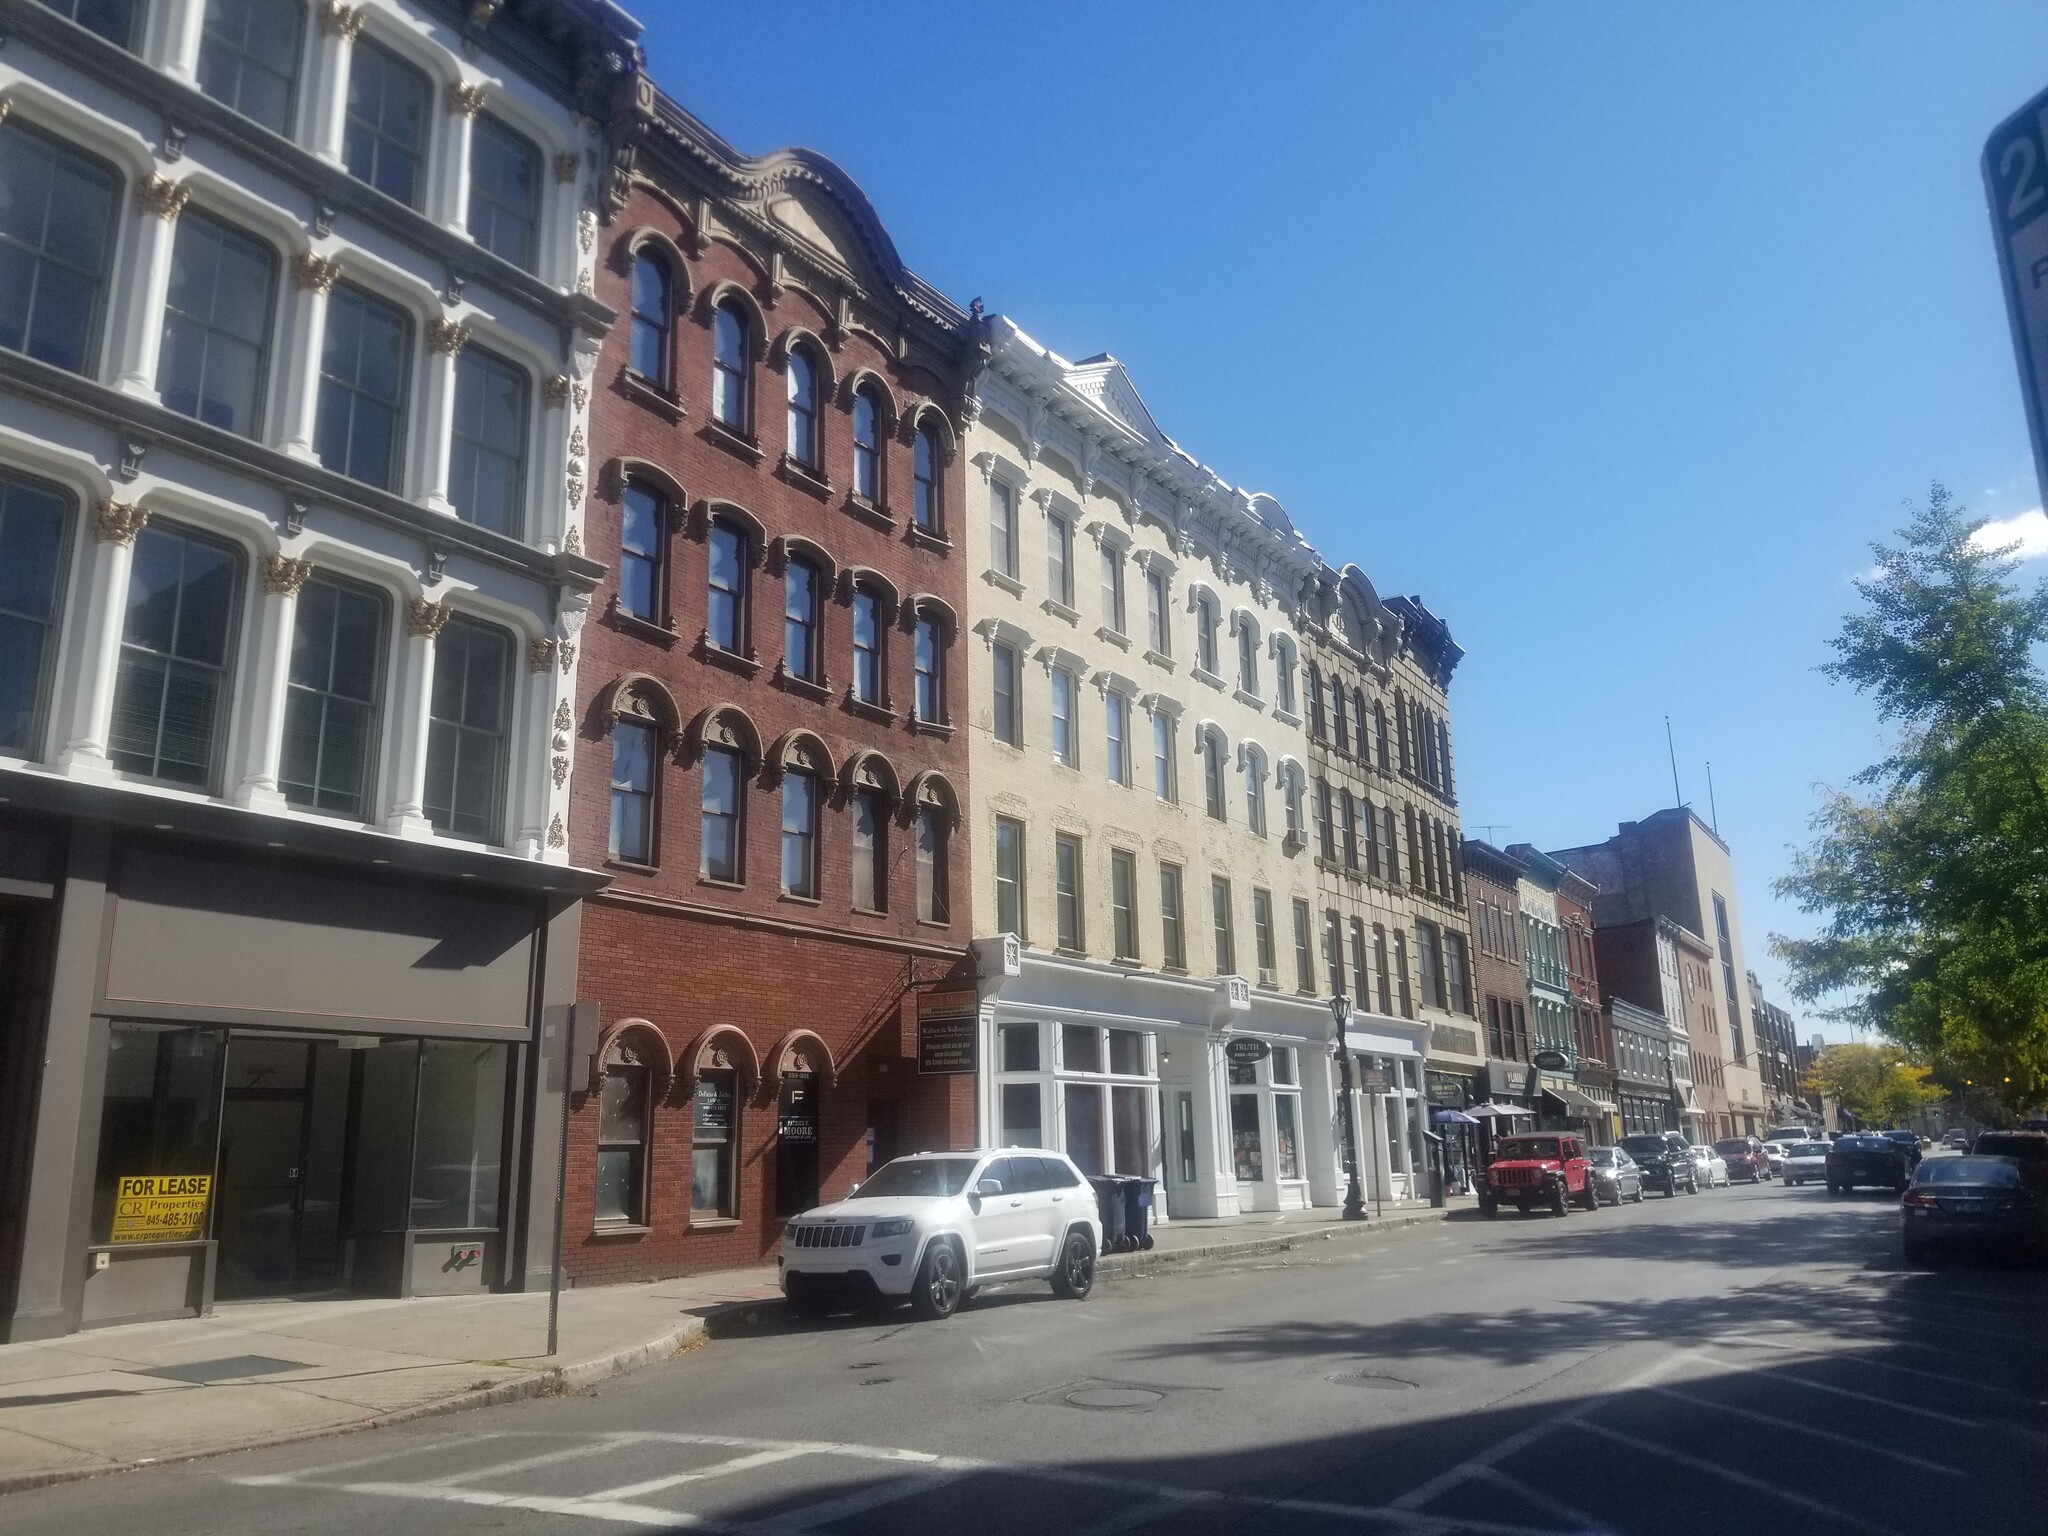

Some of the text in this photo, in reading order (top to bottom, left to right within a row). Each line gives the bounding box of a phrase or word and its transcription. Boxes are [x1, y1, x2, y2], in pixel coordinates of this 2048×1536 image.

[1235, 1043, 1259, 1051] TRUTH
[783, 1126, 813, 1135] MOORE
[122, 1178, 208, 1196] FOR LEASE
[120, 1199, 205, 1215] CR Properties
[146, 1212, 205, 1226] 845-485-3100
